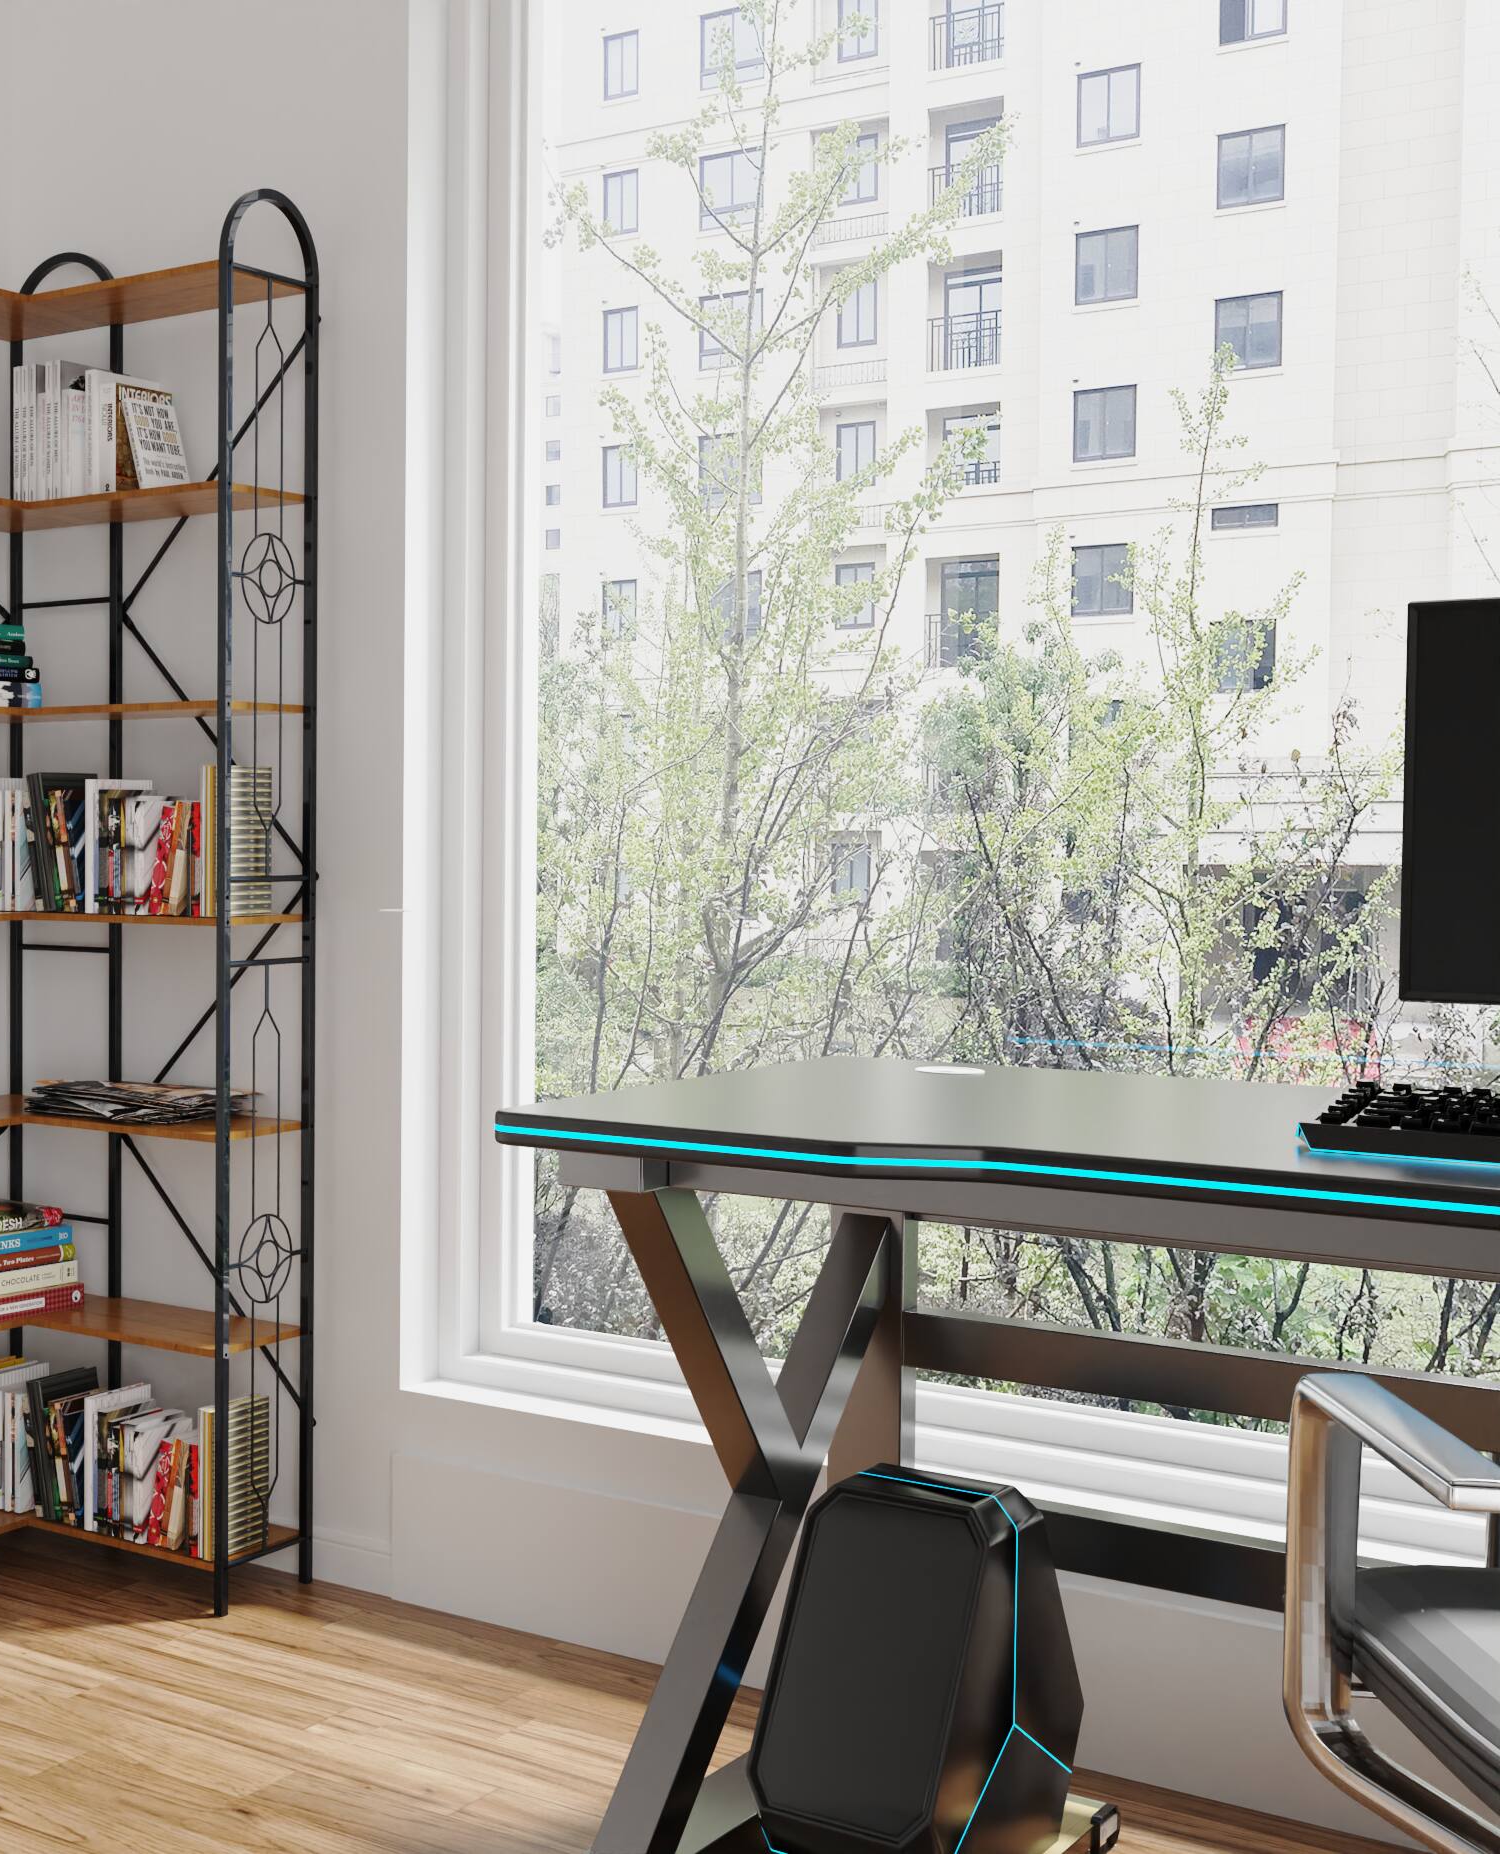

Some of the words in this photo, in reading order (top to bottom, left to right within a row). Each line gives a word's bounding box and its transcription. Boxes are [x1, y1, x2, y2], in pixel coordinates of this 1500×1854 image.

[132, 403, 143, 415] IT'S
[144, 405, 154, 417] NOT
[157, 407, 169, 419] HOW
[150, 418, 162, 430] YOU
[137, 427, 148, 439] IT'S
[149, 429, 161, 440] HOW
[139, 439, 150, 450] YOU
[150, 440, 166, 452] WANT
[16, 1256, 35, 1264] Plates
[1, 1274, 40, 1287] CHOCOLATE
